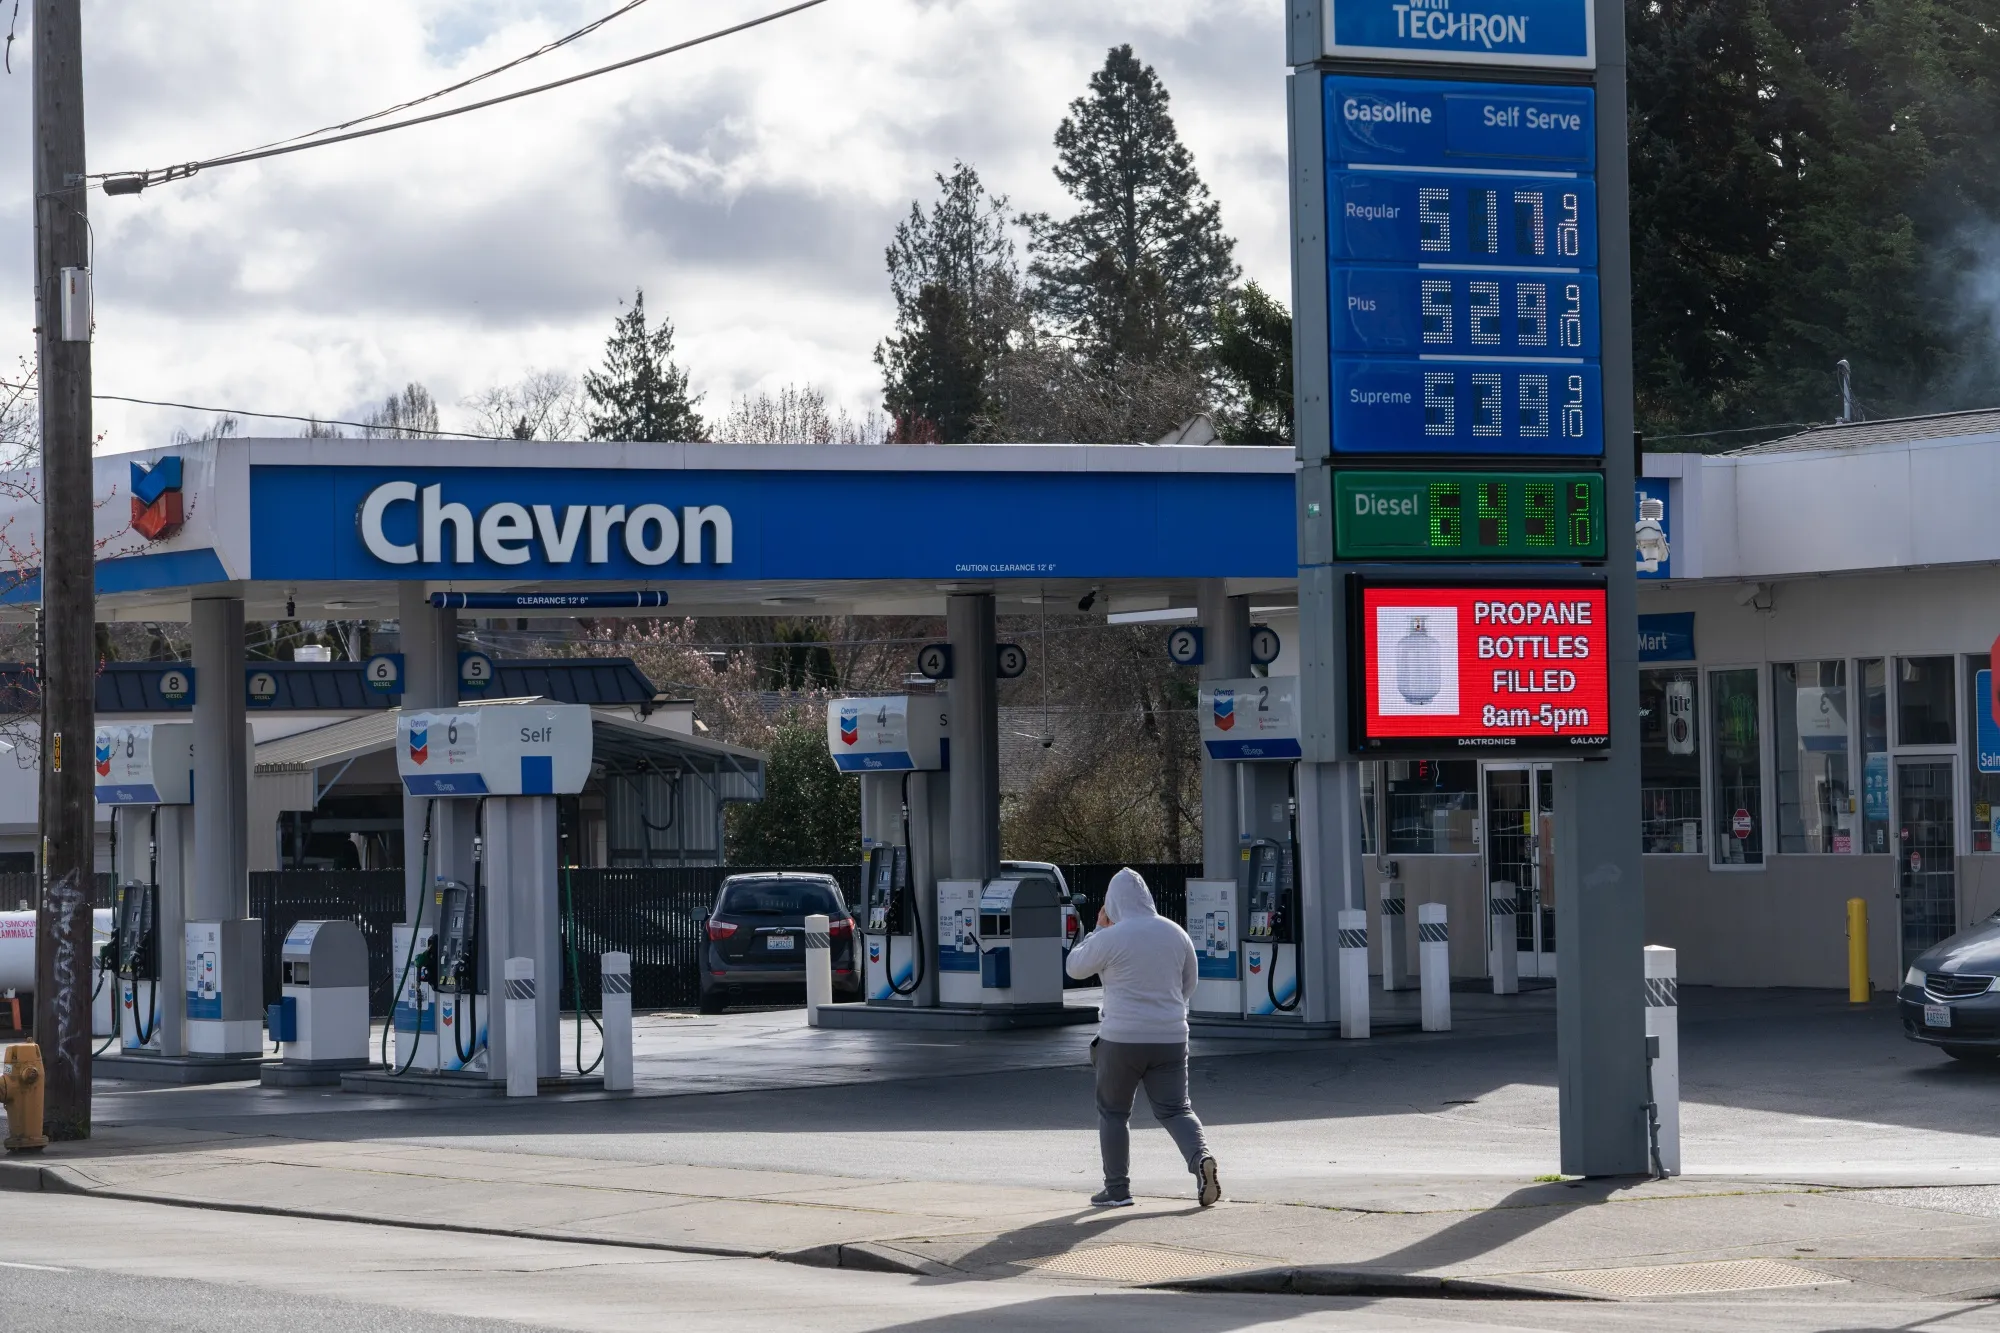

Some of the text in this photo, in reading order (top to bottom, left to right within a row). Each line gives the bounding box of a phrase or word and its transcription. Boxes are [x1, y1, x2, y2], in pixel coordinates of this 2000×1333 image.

[1392, 5, 1526, 48] TECHRON
[1343, 99, 1432, 124] Gasoline
[1483, 105, 1581, 130] Self Serve
[1346, 203, 1401, 220] Regular
[1348, 296, 1376, 311] Plus
[1350, 389, 1411, 405] Supreme
[1355, 493, 1418, 515] Diesel
[361, 480, 733, 567] Chevron
[955, 564, 989, 572] CAUTION
[990, 564, 1035, 572] CLEARANCE
[517, 596, 566, 605] CLEARANCE
[1474, 601, 1592, 625] PROPANE
[1178, 637, 1190, 655] 2
[1261, 637, 1269, 654] 1
[1477, 635, 1589, 659] BOTTLES
[1638, 632, 1667, 650] Mart
[471, 661, 482, 677] 5
[927, 654, 940, 670] 4
[1006, 653, 1017, 669] 3
[376, 664, 388, 678] 6
[168, 676, 179, 690] 8
[257, 678, 267, 692] 7
[1493, 669, 1576, 693] FILLED
[1258, 685, 1269, 712] 2
[1669, 695, 1691, 717] Lite
[877, 704, 887, 727] 4
[1482, 704, 1589, 732] 8am-5pm
[448, 716, 457, 745] 6
[520, 727, 552, 743] Self
[126, 733, 134, 758] 8
[1458, 738, 1517, 746] DAKTRONICS
